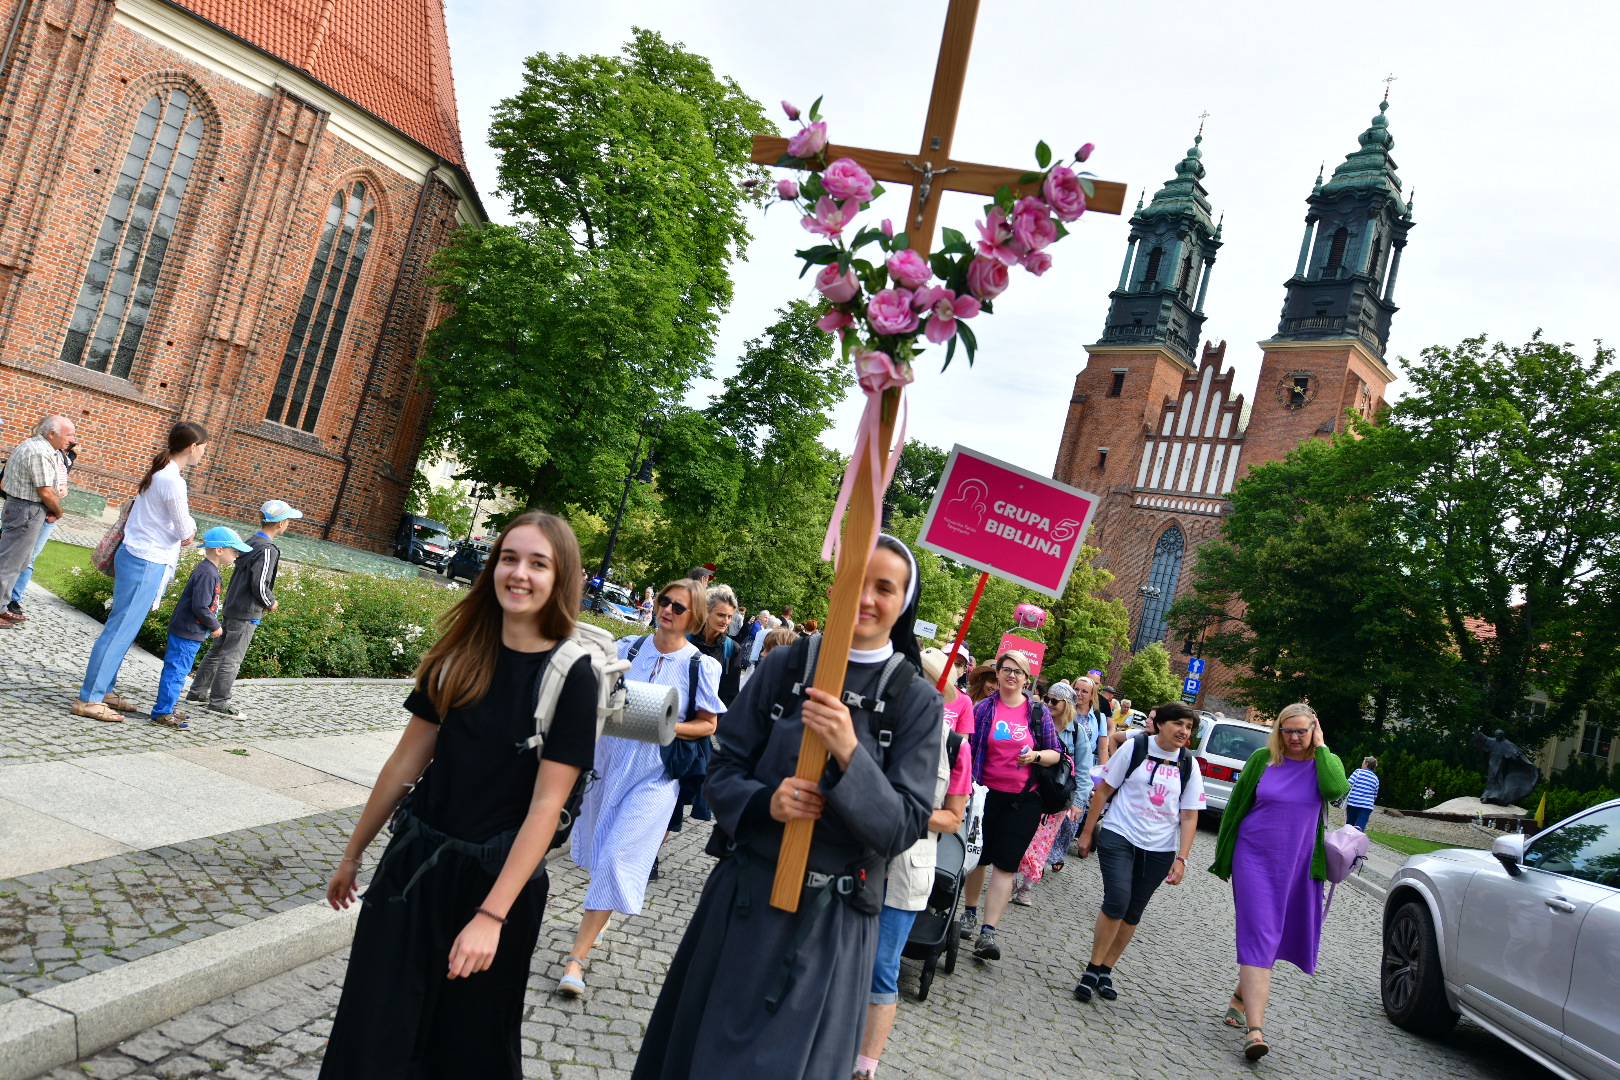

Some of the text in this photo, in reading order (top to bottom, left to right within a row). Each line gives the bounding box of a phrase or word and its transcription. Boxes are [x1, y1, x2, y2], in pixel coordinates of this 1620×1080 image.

[993, 500, 1050, 532] GRUPA
[1050, 518, 1080, 542] 5
[984, 518, 1062, 558] BIBLIJNA
[1187, 680, 1197, 691] P
[1012, 725, 1027, 741] 5
[1145, 760, 1180, 780] Gupa
